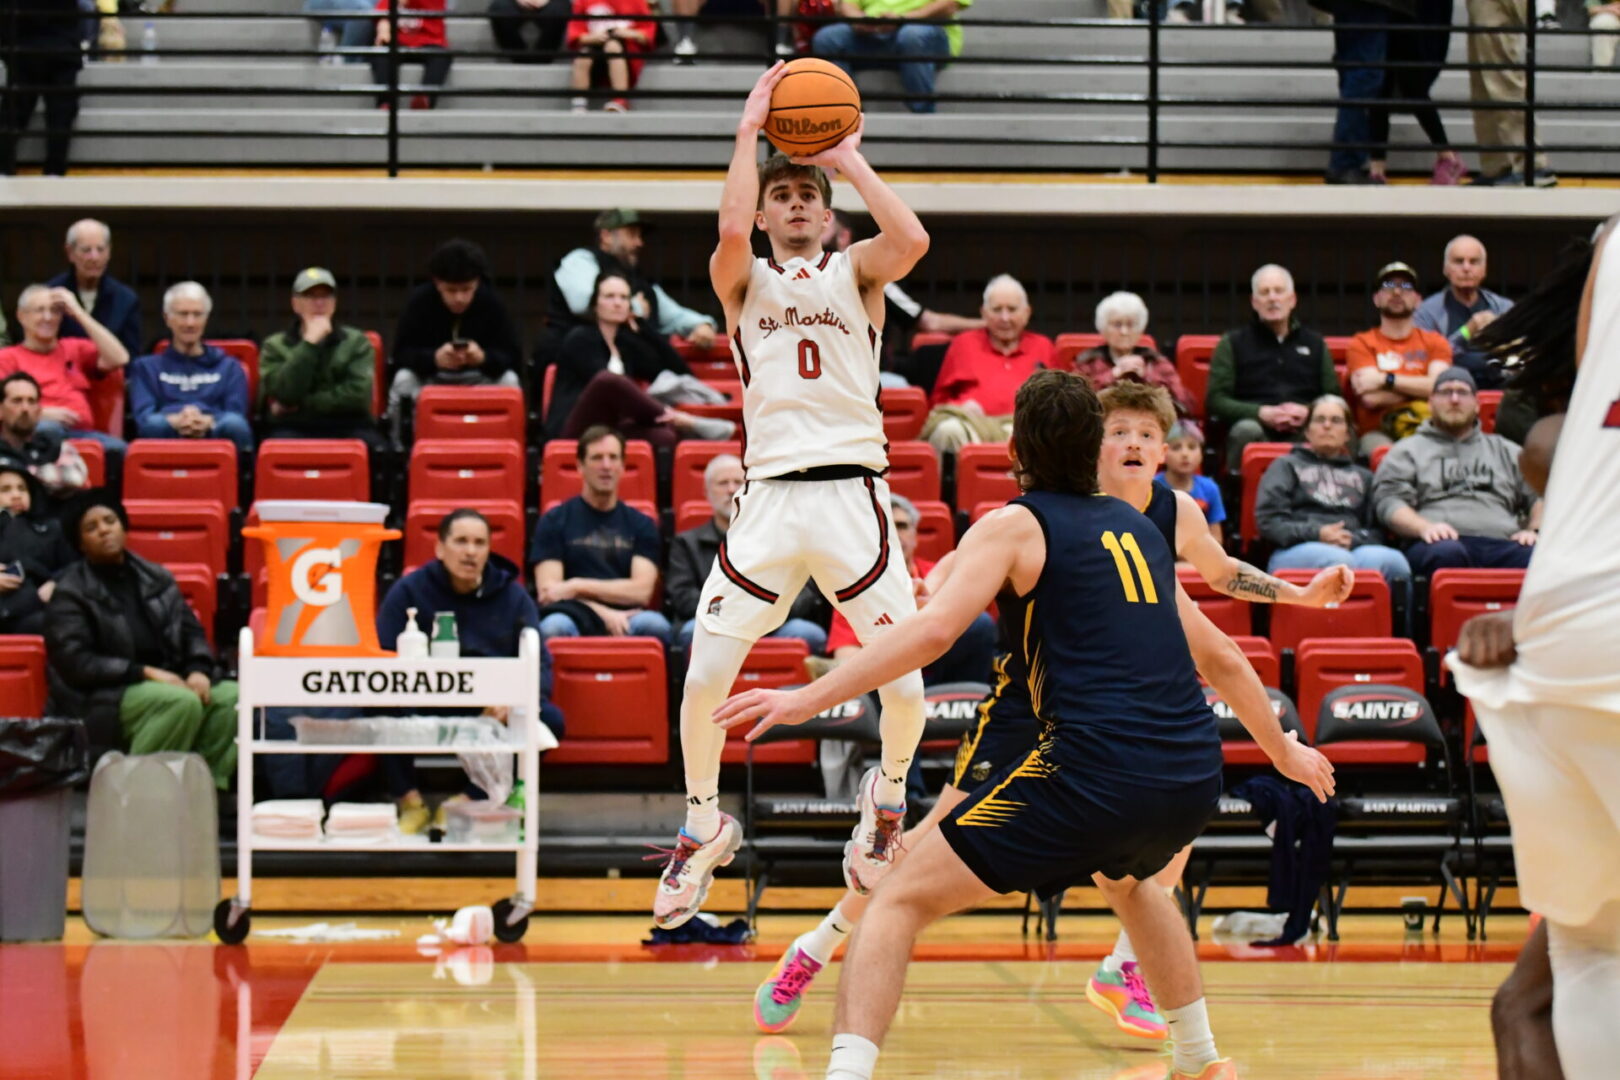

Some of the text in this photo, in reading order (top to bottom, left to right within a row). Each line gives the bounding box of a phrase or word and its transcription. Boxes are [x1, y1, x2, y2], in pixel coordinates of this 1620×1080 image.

[775, 117, 841, 134] Wilson
[759, 317, 782, 339] St.
[798, 339, 822, 379] 0
[291, 548, 342, 606] G
[1100, 530, 1159, 604] 11
[1227, 572, 1277, 602] Family
[302, 671, 475, 694] GATORADE
[1333, 701, 1419, 720] SAINTS
[1363, 802, 1396, 813] SAINT
